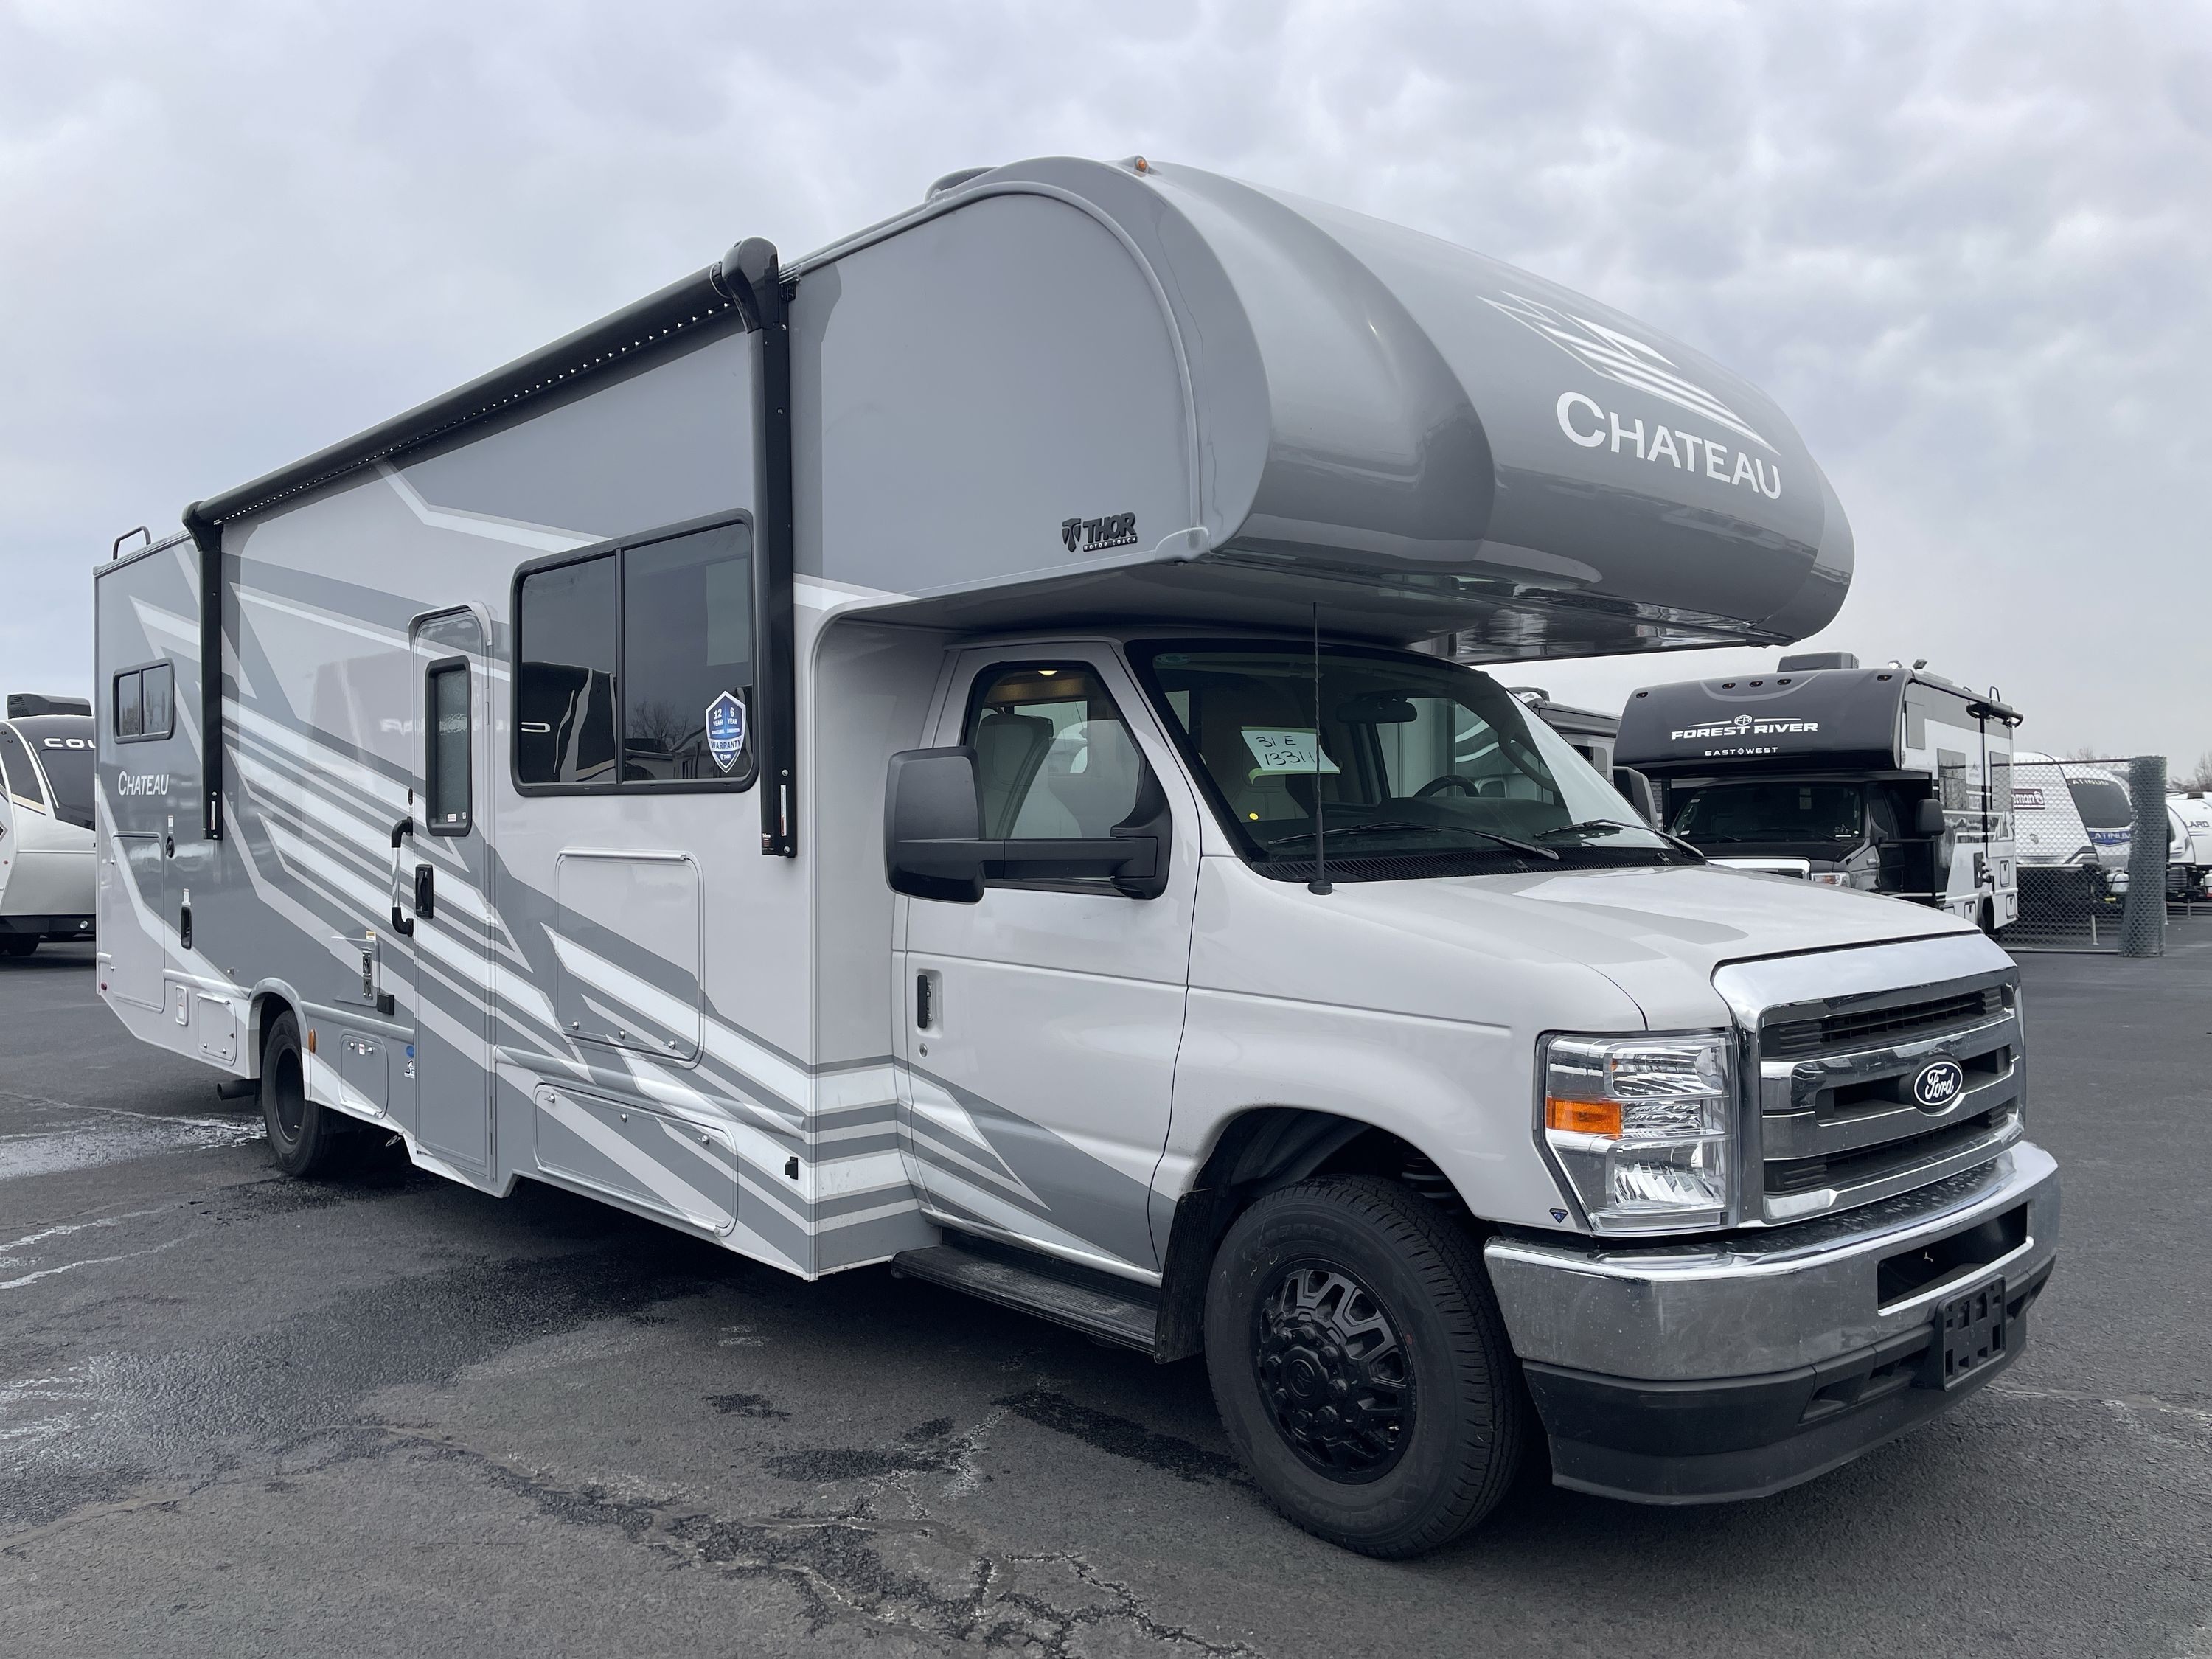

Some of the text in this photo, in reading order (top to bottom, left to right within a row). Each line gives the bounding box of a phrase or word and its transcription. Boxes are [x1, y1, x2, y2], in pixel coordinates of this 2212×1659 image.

[1557, 392, 1782, 500] CHATEAU
[1083, 512, 1137, 543] THOR
[1084, 537, 1136, 551] MOTOR COACH
[714, 707, 735, 720] 12 6
[1284, 735, 1297, 745] E
[1671, 723, 1818, 740] FOREST RIVER
[711, 739, 742, 750] WARRANTY
[118, 771, 170, 796] CHATEAU
[1924, 1067, 1955, 1100] Ford
